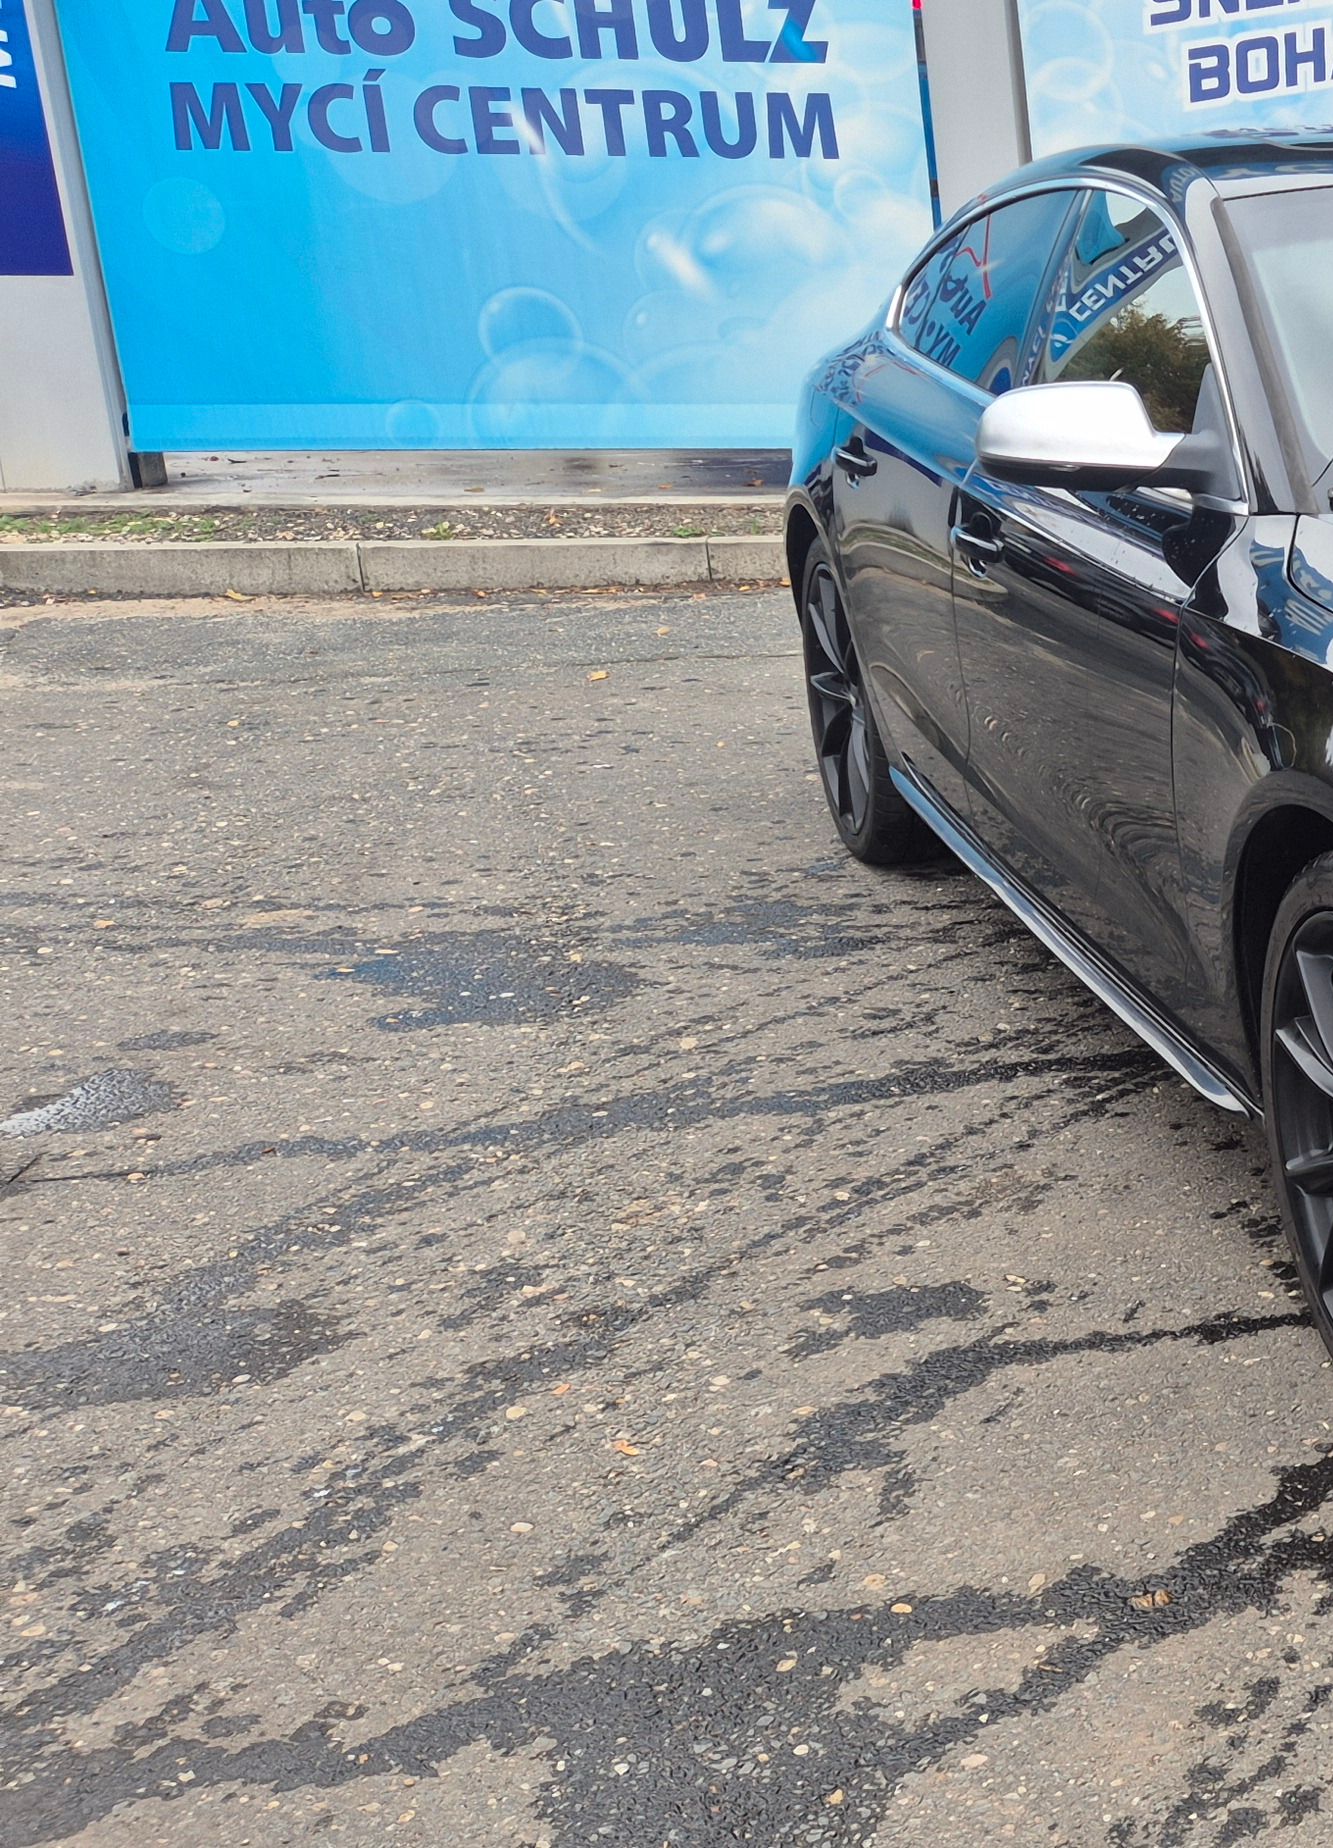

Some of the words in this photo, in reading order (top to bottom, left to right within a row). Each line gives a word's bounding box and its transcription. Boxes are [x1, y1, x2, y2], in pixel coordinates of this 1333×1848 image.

[165, 0, 416, 56] Auto
[449, 0, 829, 64] SCHULZ
[169, 68, 391, 153] MYCÍ
[413, 85, 840, 160] CENTRUM
